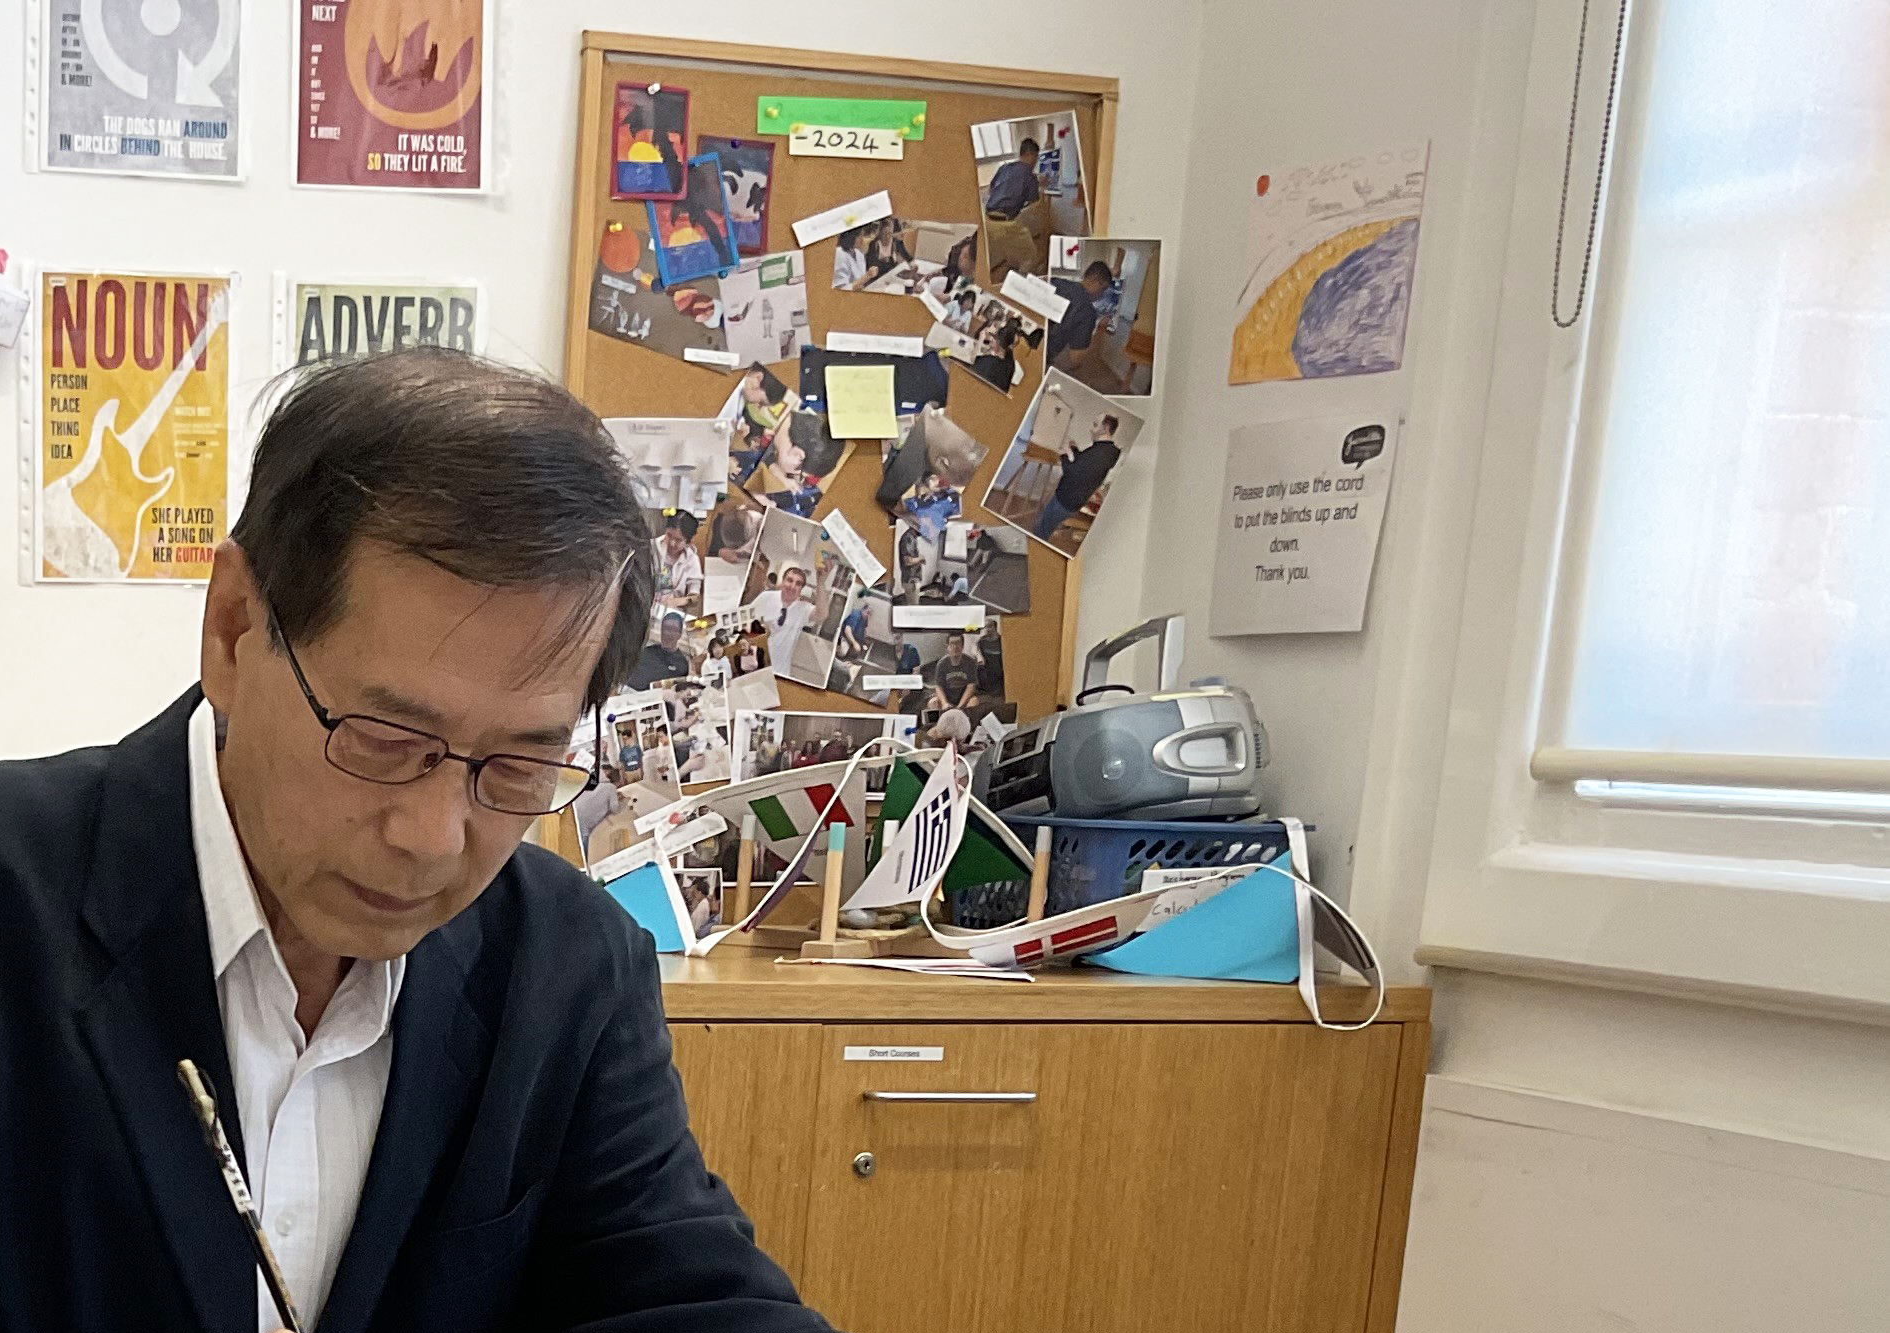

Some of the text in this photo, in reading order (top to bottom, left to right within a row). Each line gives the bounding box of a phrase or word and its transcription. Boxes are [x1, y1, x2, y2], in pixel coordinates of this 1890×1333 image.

[312, 5, 337, 22] NEXT
[103, 116, 228, 139] THE DOGS RAN AROUND
[60, 134, 71, 151] IN
[74, 134, 118, 155] CIRCLES
[121, 137, 161, 156] BEHIND
[164, 139, 184, 158] THE
[398, 133, 467, 156] IT WAS COLD,
[812, 130, 879, 154] 2024
[367, 152, 381, 171] SO
[384, 153, 409, 172] THEY
[412, 155, 427, 171] LIT
[430, 155, 439, 172] A
[52, 279, 209, 372] NOUN
[50, 374, 88, 390] PERSON
[50, 397, 80, 413] PLACE
[50, 420, 80, 437] THING
[51, 444, 73, 460] IDEA
[1233, 474, 1365, 501] Please only use the cord
[152, 508, 214, 524] SHE PLAYED
[1234, 503, 1358, 531] to put the blinds up and
[158, 527, 214, 543] A SONG ON
[1270, 536, 1300, 553] down.
[153, 546, 213, 563] HER GUITAR
[1255, 565, 1309, 585] Thank you.
